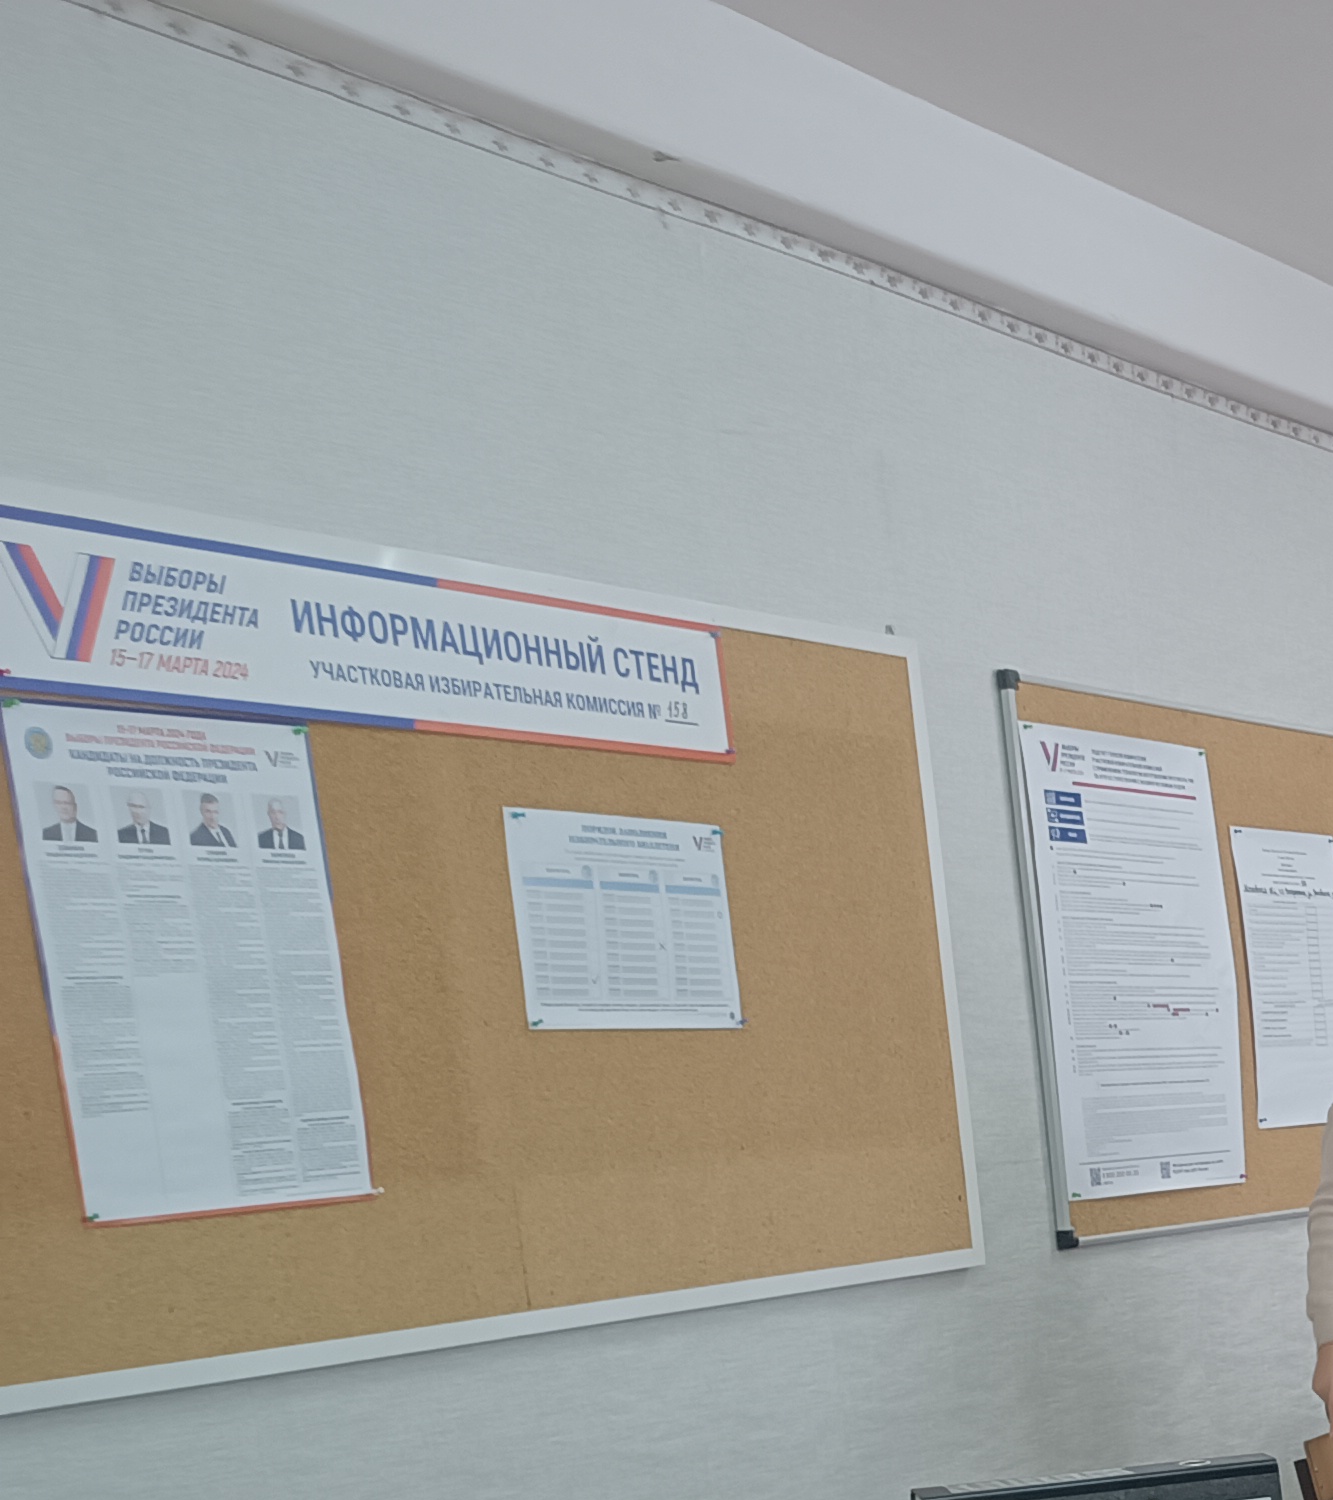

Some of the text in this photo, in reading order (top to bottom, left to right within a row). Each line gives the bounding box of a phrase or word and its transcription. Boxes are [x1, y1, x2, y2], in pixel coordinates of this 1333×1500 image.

[128, 561, 227, 594] ВЫБОРЫ
[121, 590, 259, 628] ПРЕЗИДЕНТА
[114, 619, 205, 650] РОССИИ
[290, 598, 700, 694] ИНФОРМАЦИОННЫЙ СТЕНД
[156, 653, 209, 676] МАРТА
[212, 660, 249, 681] 2024
[309, 659, 425, 691] УЧАСТКОВАЯ
[428, 674, 563, 708] ИЗБИРАТЕЛЬНАЯ
[566, 692, 645, 718] КОМИССИЯ
